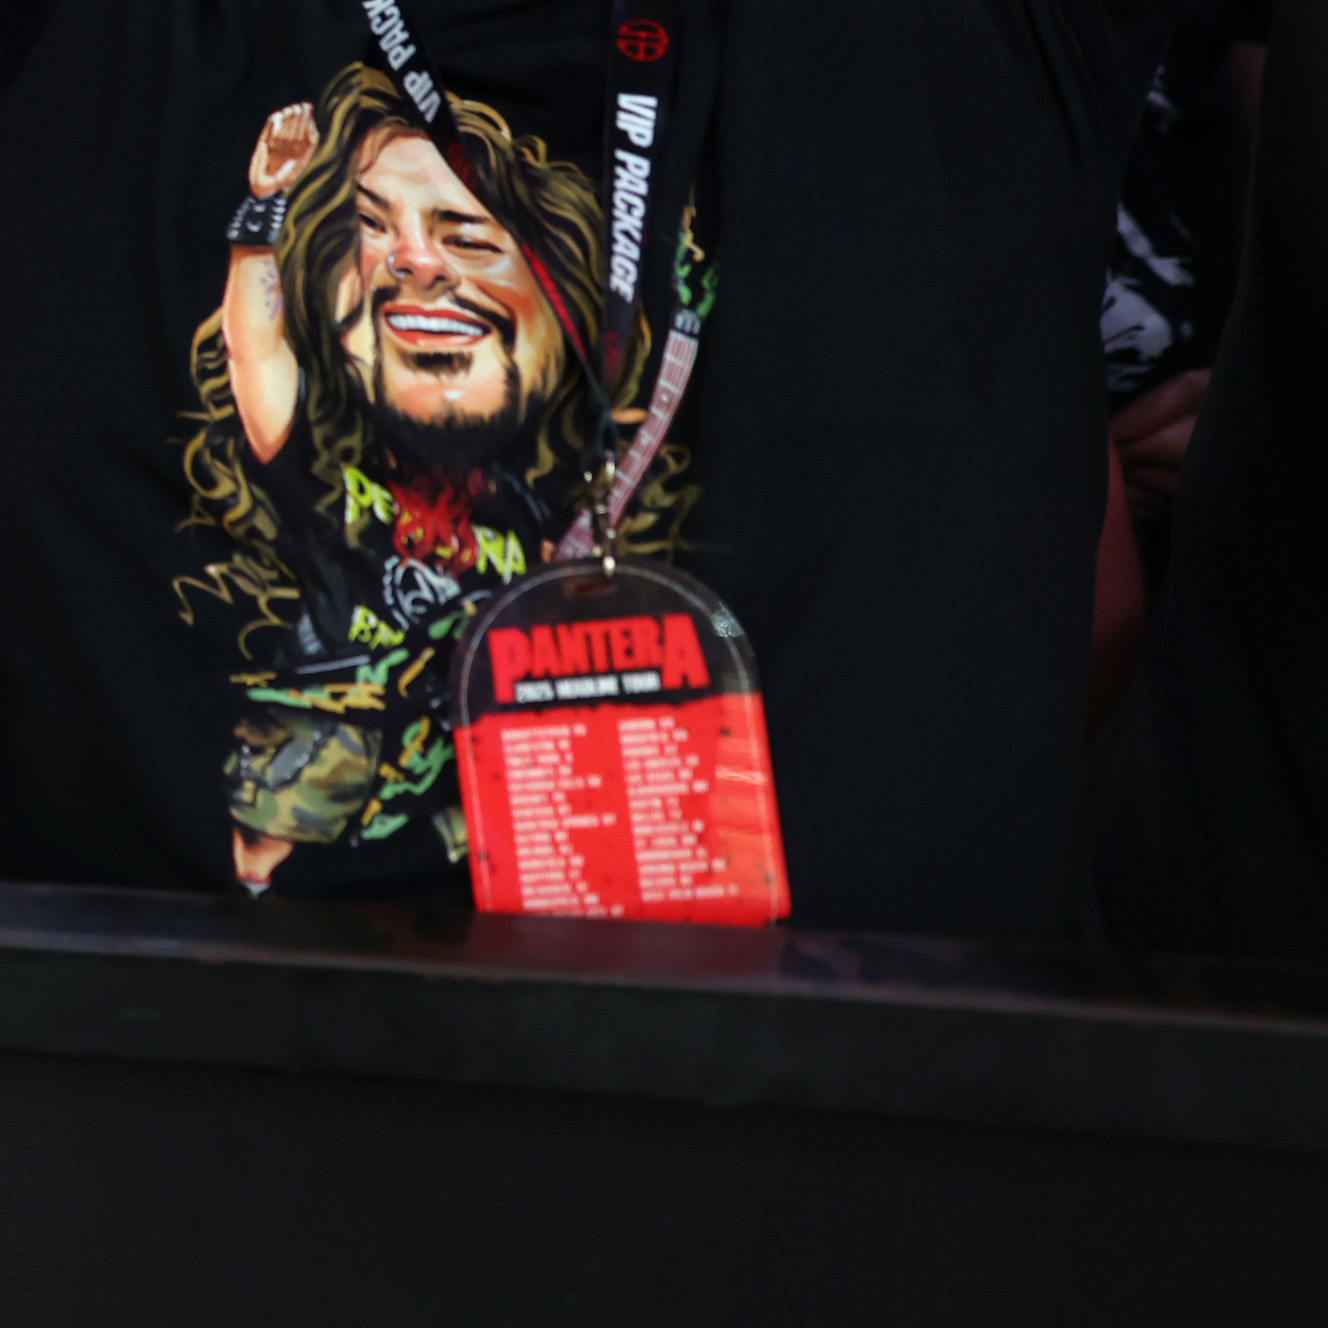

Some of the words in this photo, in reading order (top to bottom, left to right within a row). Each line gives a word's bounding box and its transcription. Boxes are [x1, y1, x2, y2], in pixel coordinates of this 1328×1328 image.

[402, 70, 443, 124] VIP
[615, 92, 659, 149] VIP
[609, 148, 652, 305] PACKAGE
[487, 611, 712, 705] PANTERA
